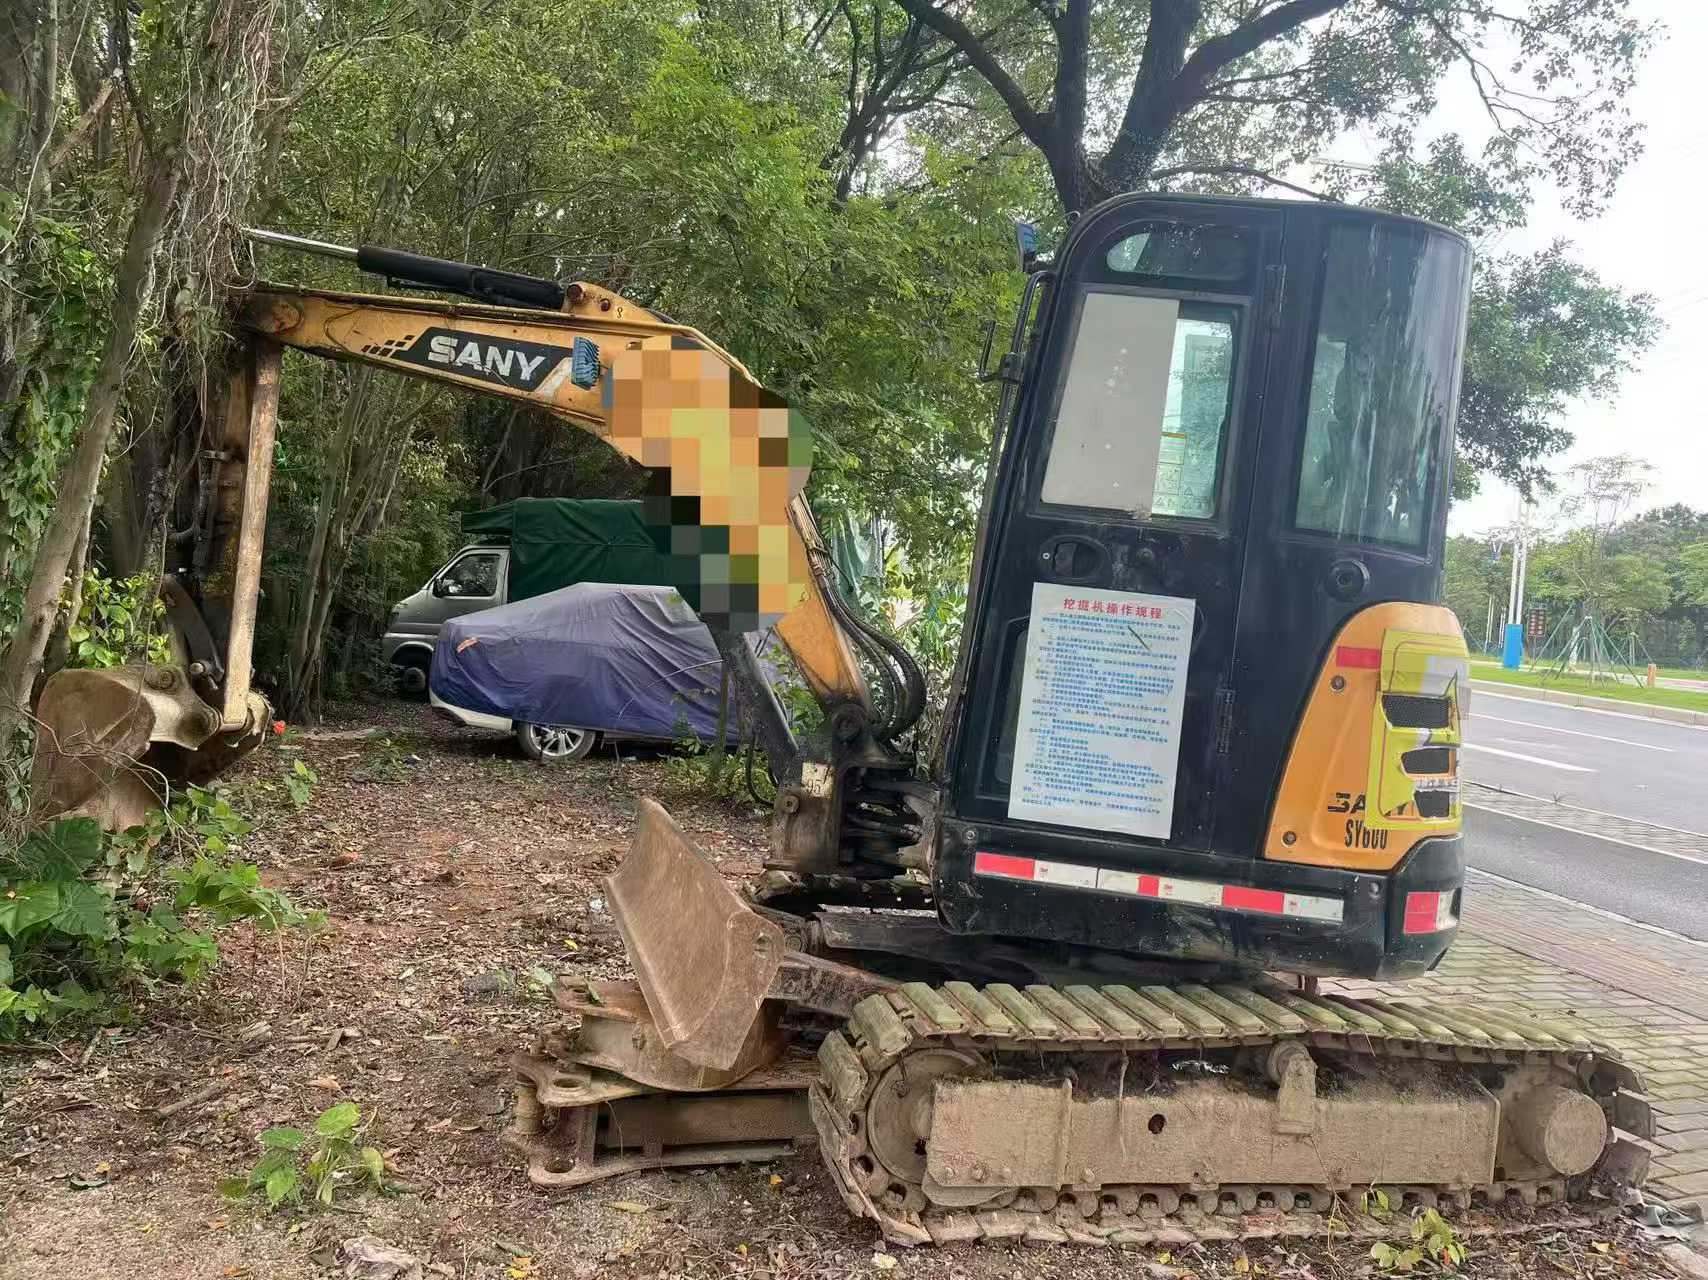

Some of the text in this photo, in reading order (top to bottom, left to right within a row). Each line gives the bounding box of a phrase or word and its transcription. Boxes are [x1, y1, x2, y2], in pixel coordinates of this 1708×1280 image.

[427, 334, 546, 381] SANY
[1063, 597, 1163, 619] 挖掘机操作规程
